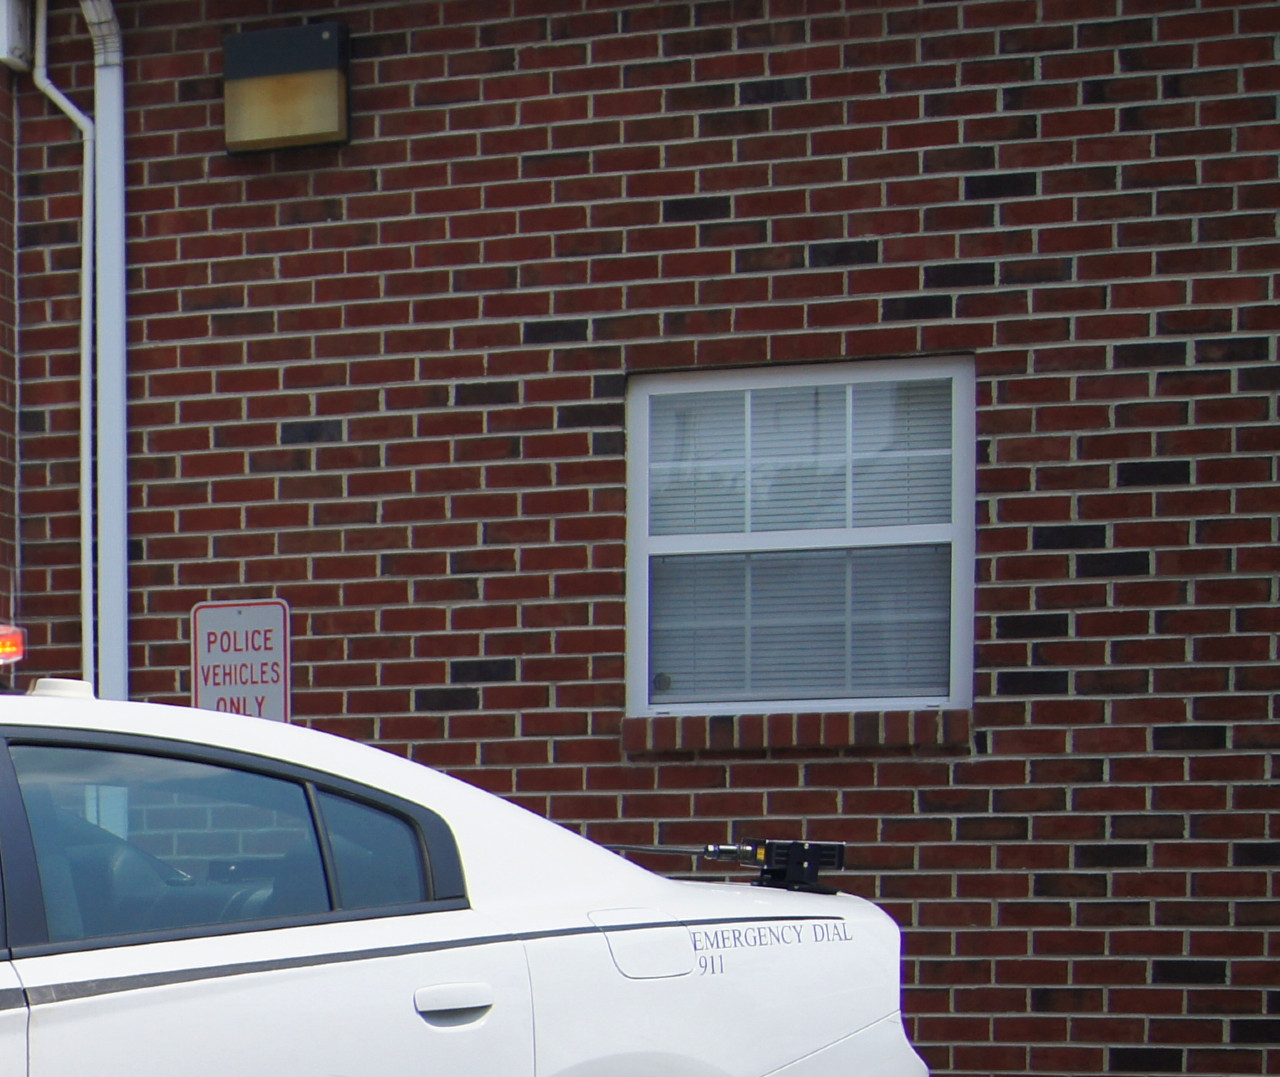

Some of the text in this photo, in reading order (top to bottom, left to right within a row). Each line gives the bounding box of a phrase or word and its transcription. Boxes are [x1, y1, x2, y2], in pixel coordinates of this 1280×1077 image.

[206, 629, 274, 653] POLICE
[201, 661, 280, 687] VEHICLES
[216, 695, 266, 718] ONLY
[692, 922, 853, 951] EMERGENCY DIAL
[698, 954, 724, 976] 911
